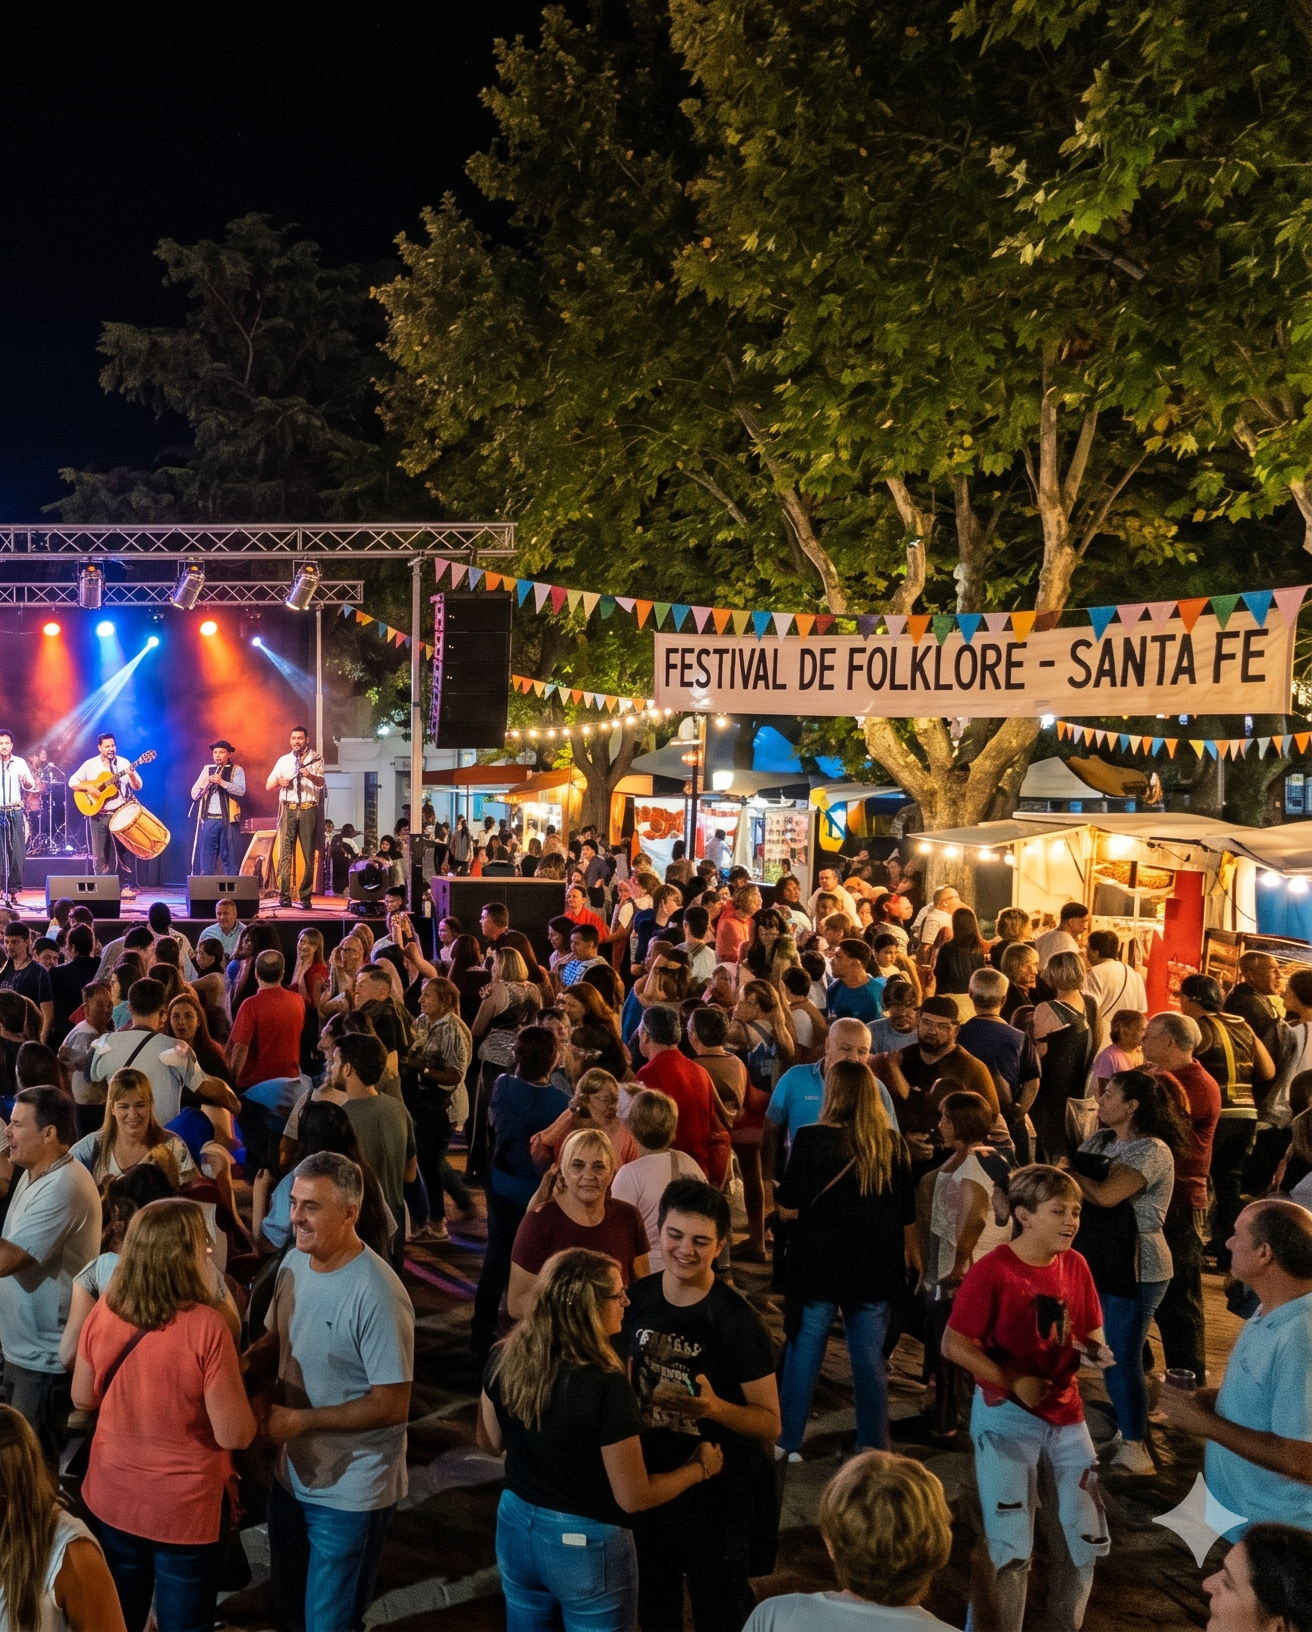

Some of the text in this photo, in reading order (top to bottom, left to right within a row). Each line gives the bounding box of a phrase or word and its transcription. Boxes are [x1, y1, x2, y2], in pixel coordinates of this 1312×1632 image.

[664, 628, 1270, 692] FESTIVAL DE FOLKLORE - SANTA FE
